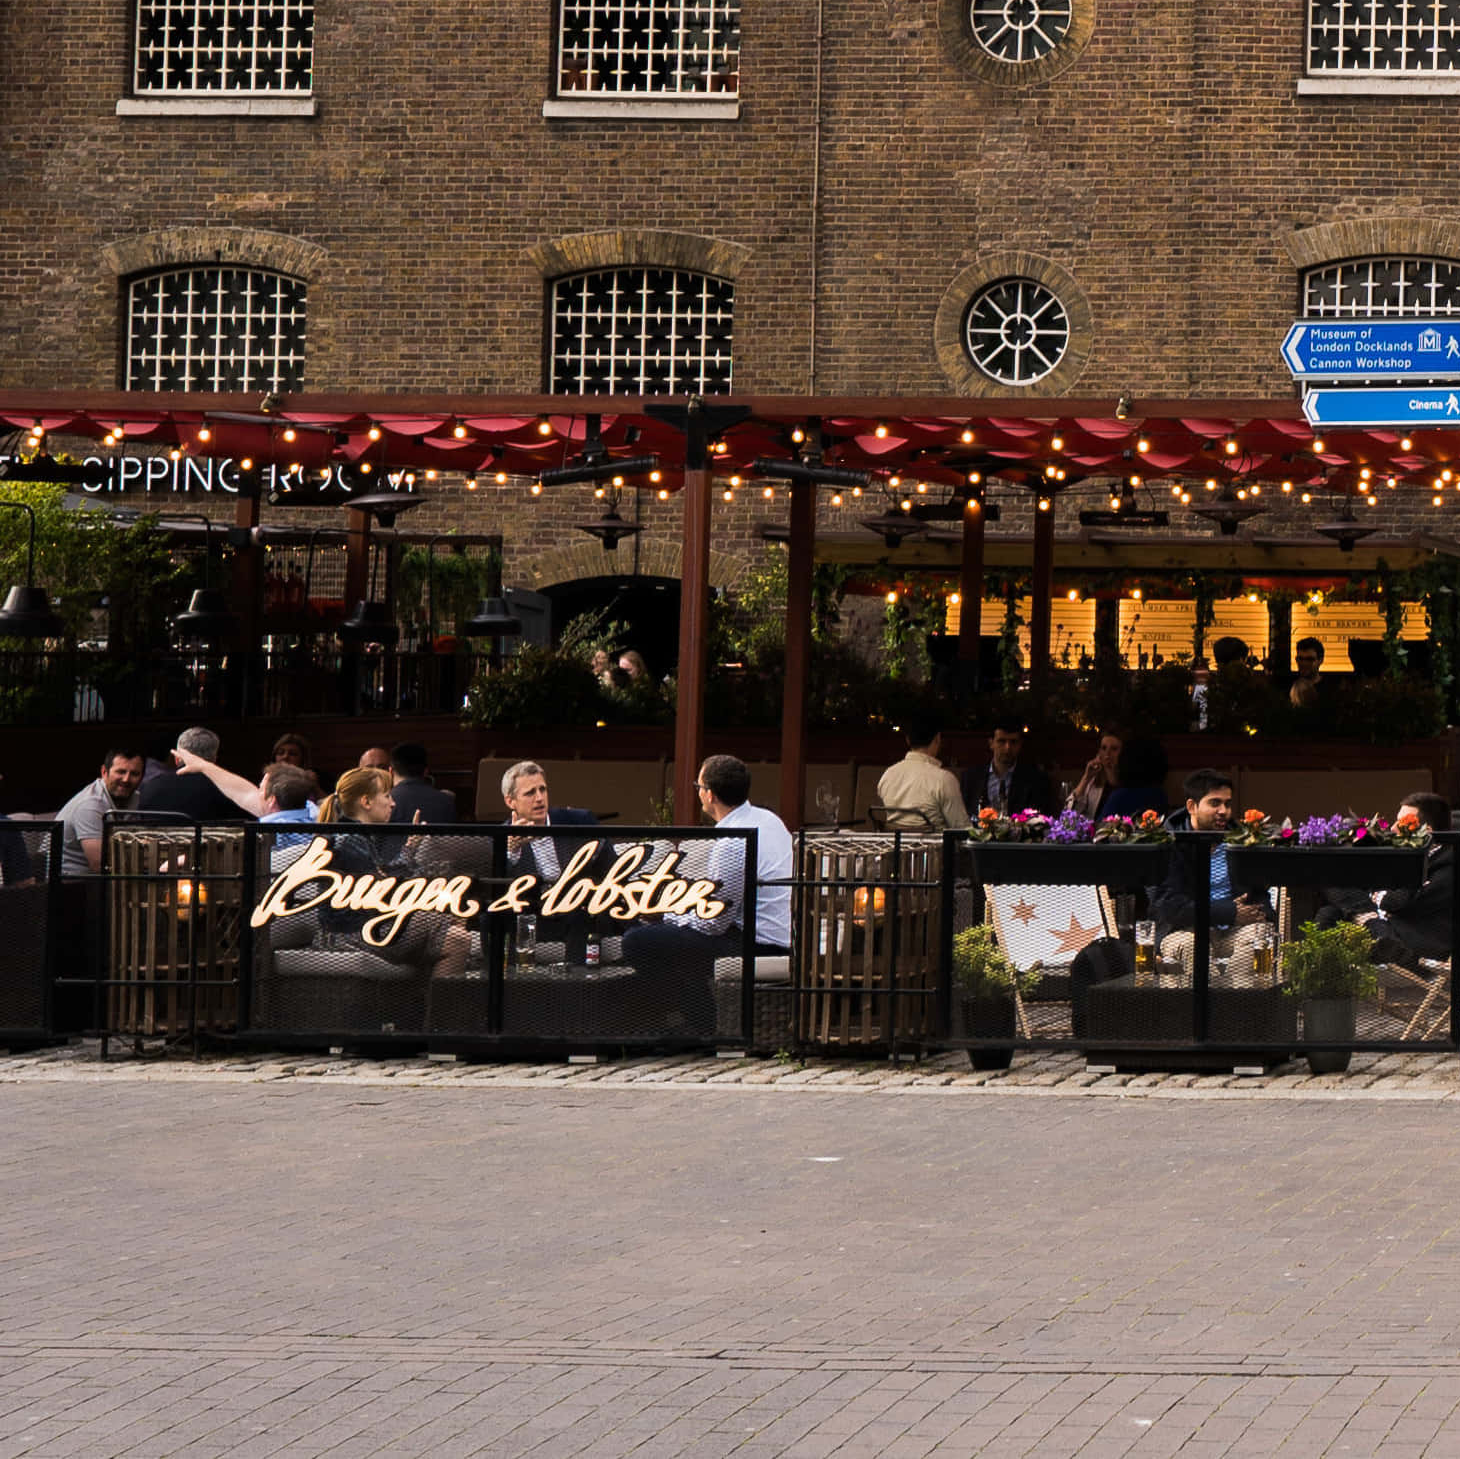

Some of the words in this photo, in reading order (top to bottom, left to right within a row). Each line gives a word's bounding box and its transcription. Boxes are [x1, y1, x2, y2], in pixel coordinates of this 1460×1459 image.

[1310, 328, 1357, 339] Museum
[1360, 328, 1373, 339] of
[1310, 341, 1351, 352] London
[1354, 340, 1414, 352] Docklands
[1309, 357, 1352, 368] Cannon
[1356, 356, 1412, 369] Workshop
[1408, 399, 1444, 410] Cinema
[250, 836, 481, 947] Burger
[486, 874, 539, 913] &
[539, 839, 727, 920] lobster
